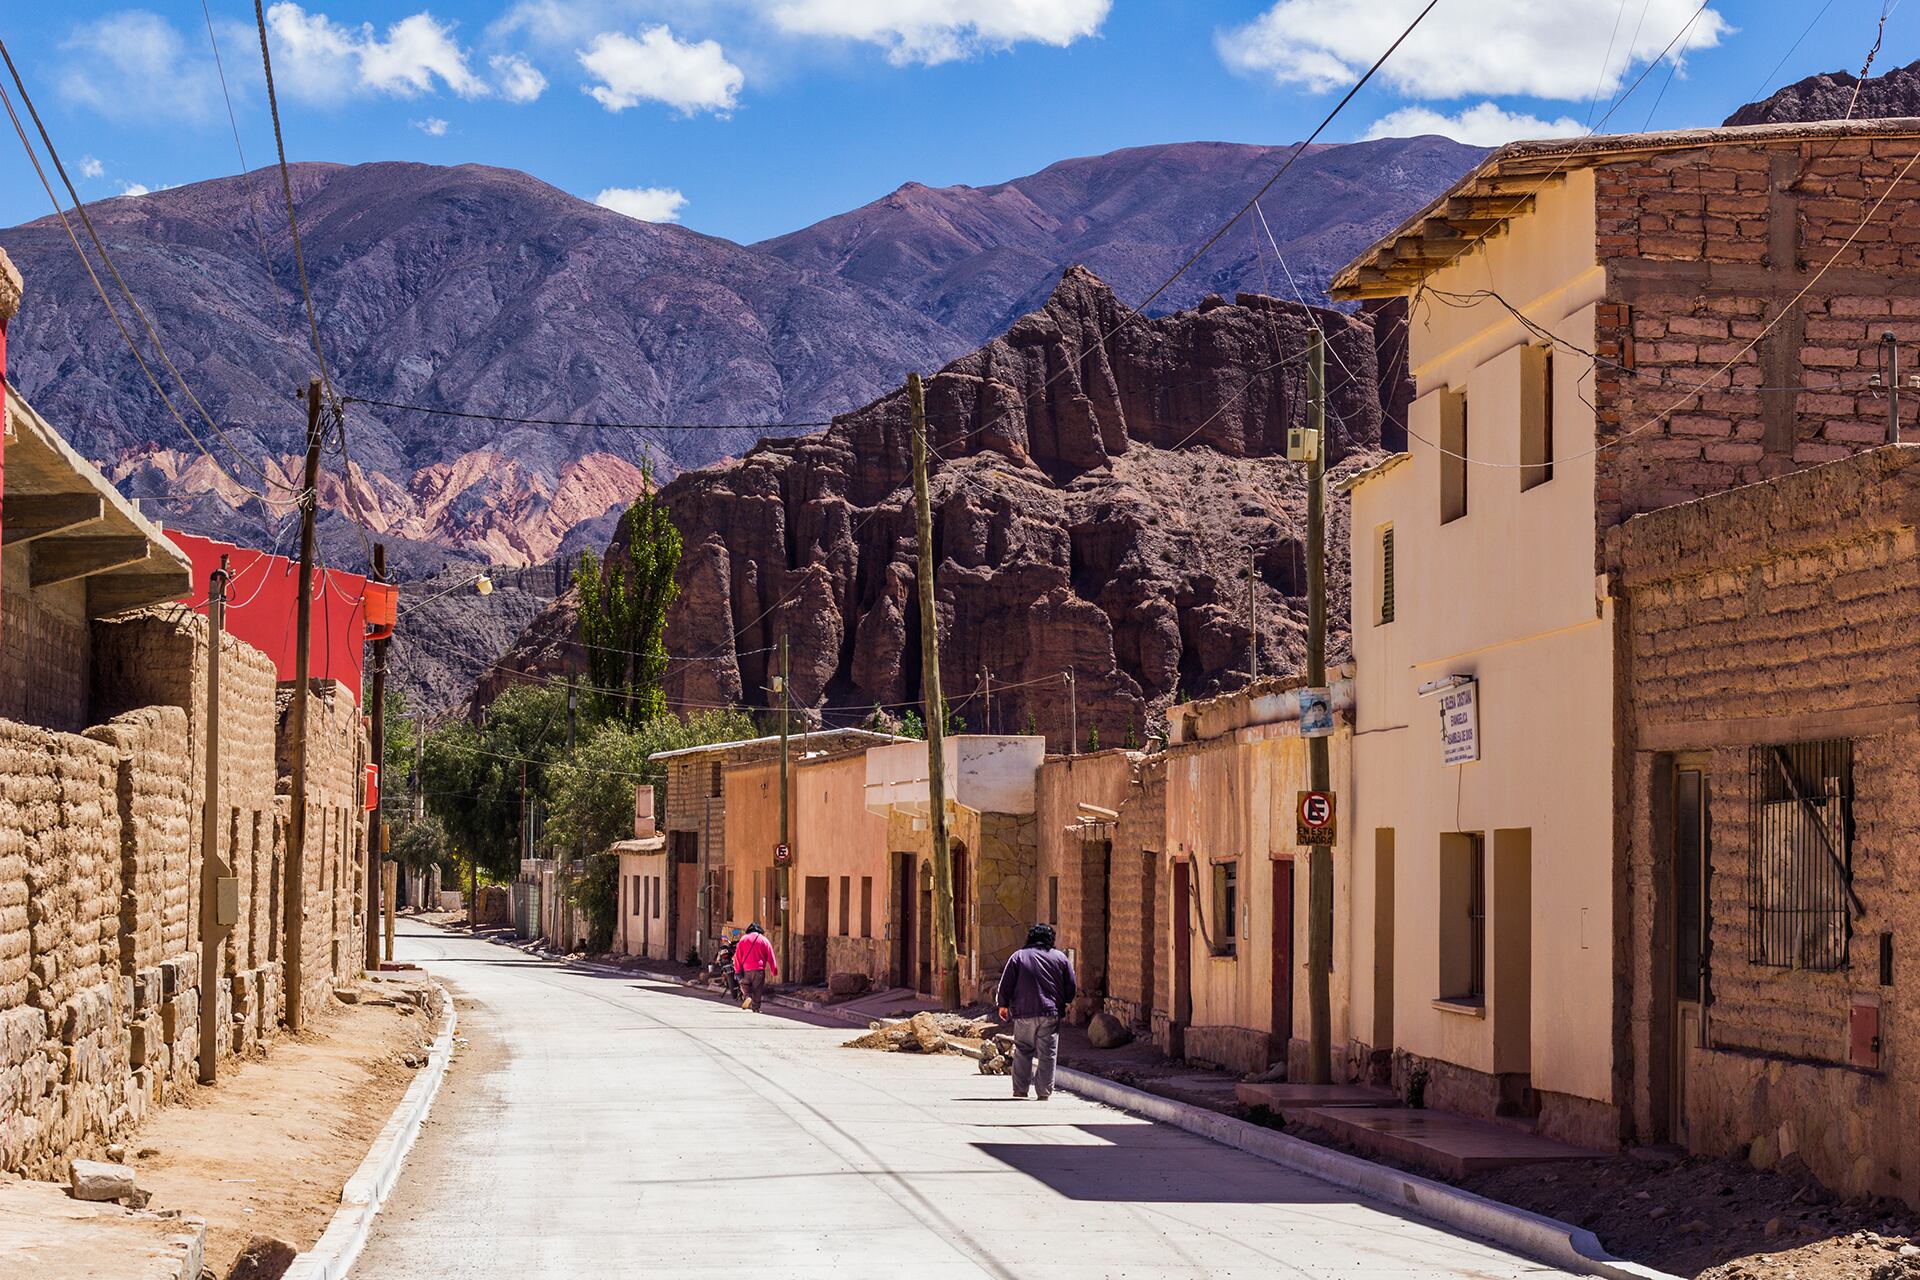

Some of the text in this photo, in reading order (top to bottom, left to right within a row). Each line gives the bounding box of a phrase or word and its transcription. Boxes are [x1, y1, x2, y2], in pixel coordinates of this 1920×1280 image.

[1308, 799, 1325, 821] E
[1297, 827, 1334, 836] EN ESTA
[1299, 835, 1333, 845] CUADRA
